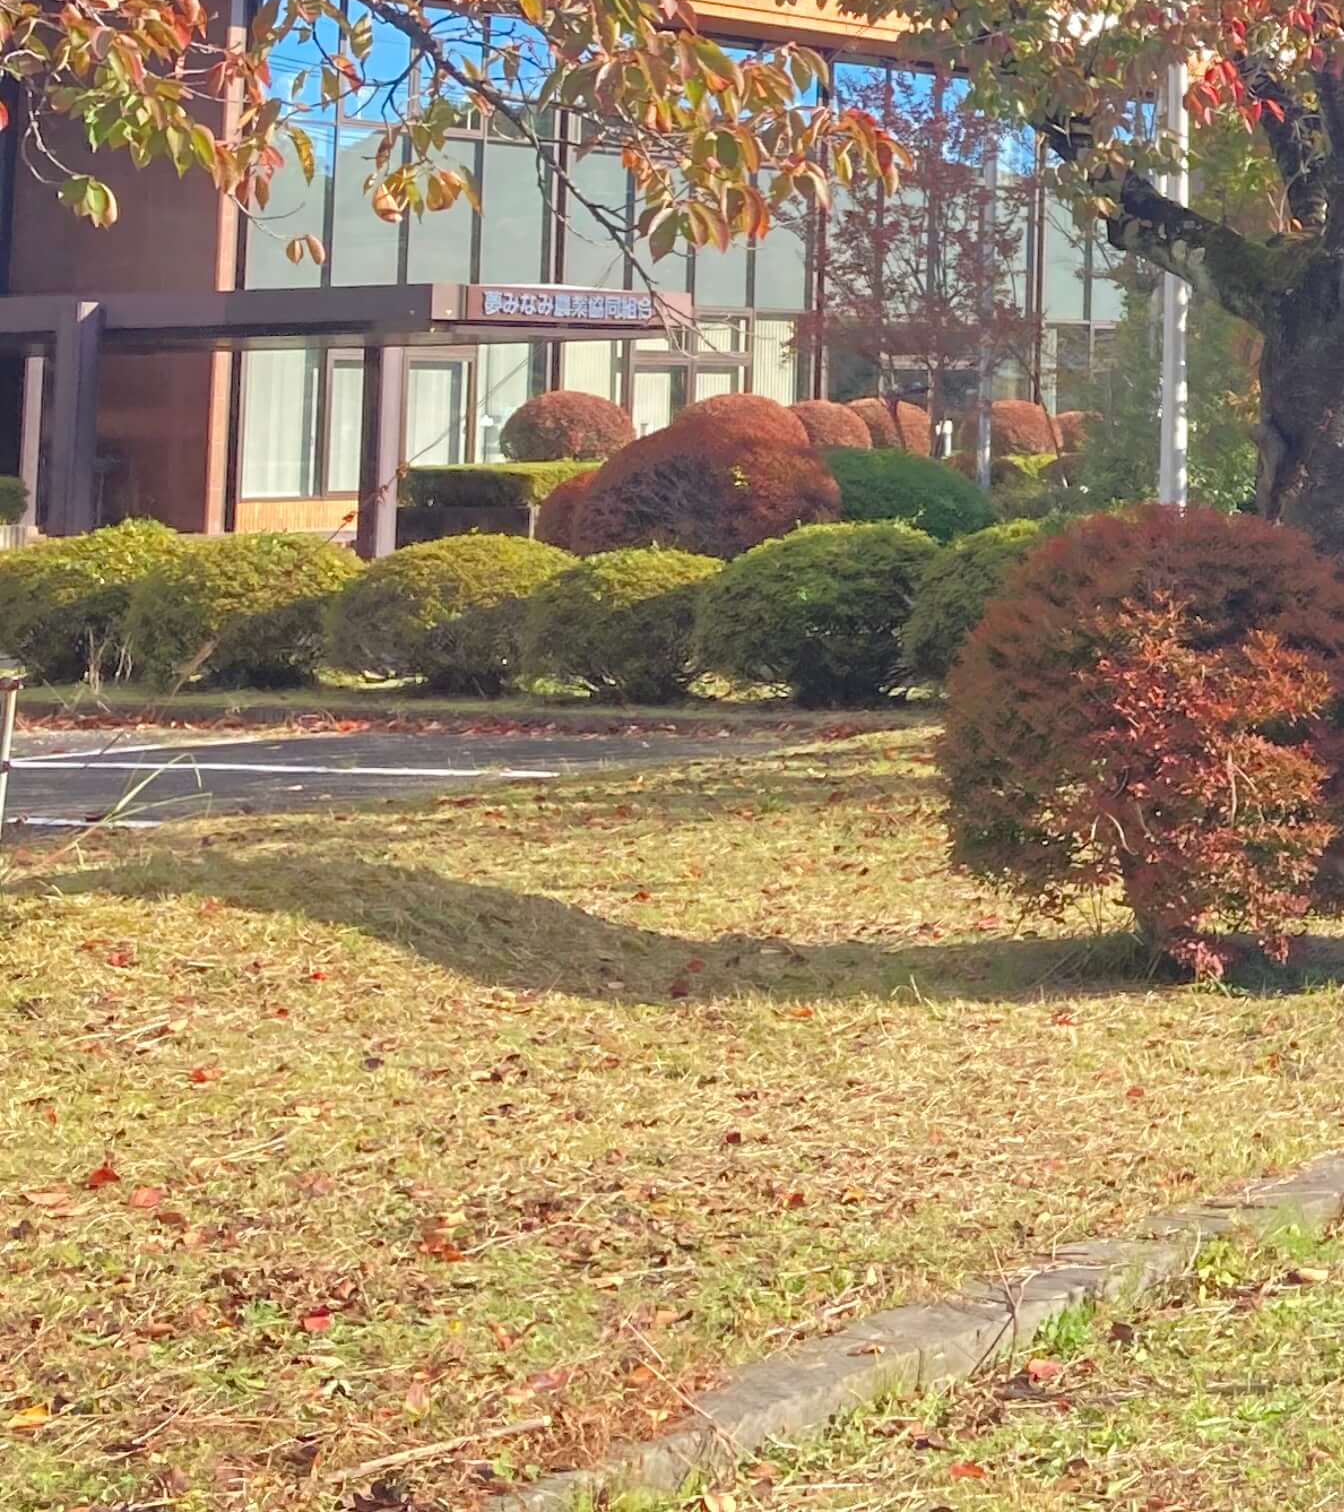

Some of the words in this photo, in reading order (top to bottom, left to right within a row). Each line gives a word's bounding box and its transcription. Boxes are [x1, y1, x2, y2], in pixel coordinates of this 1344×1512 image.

[484, 291, 652, 319] 夢みなみ農業協同組合
